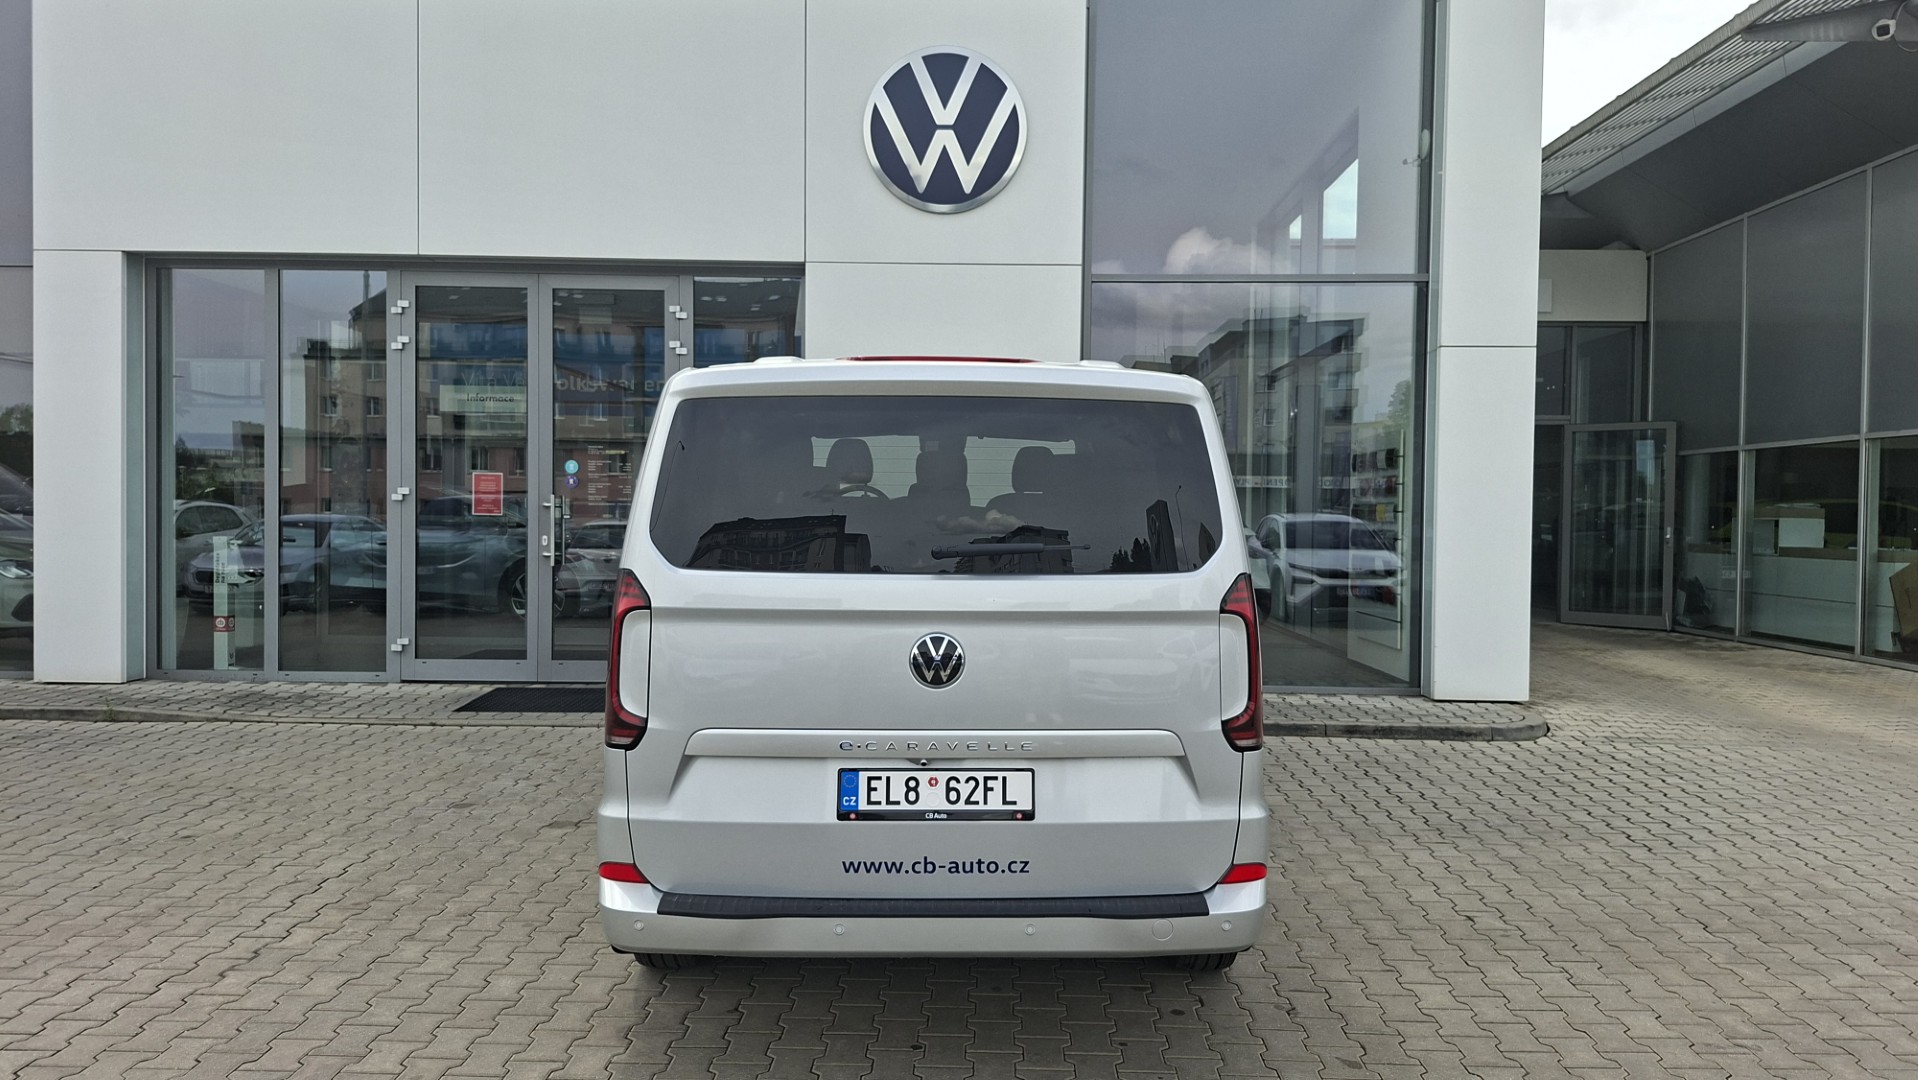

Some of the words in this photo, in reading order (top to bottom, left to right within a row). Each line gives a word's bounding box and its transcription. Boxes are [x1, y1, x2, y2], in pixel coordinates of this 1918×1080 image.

[466, 392, 515, 402] Informace
[866, 775, 920, 806] EL8
[945, 775, 1018, 806] 62FL
[842, 796, 857, 806] CZ
[841, 856, 1031, 874] www.cb-auto.cz
